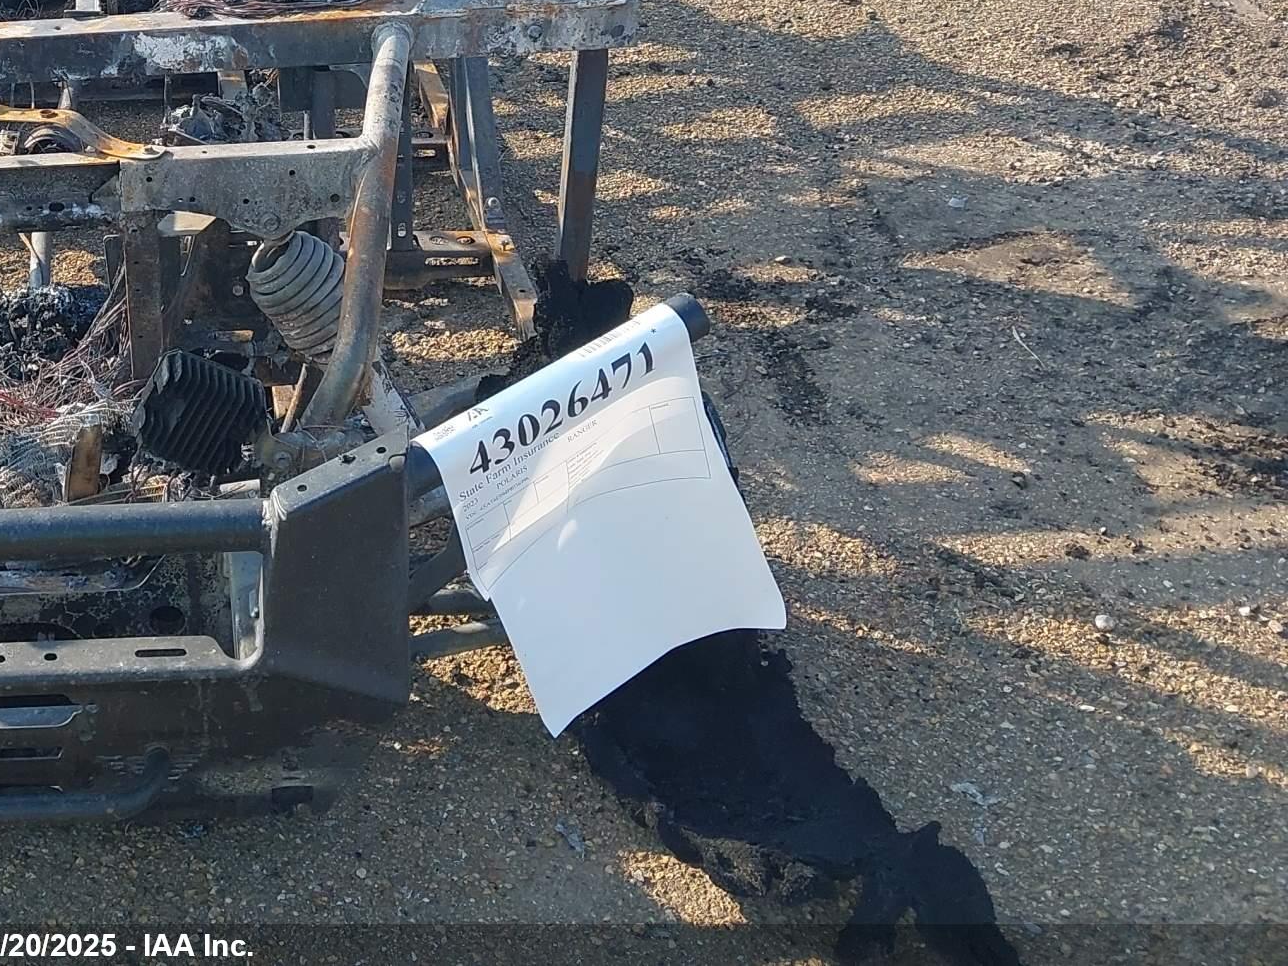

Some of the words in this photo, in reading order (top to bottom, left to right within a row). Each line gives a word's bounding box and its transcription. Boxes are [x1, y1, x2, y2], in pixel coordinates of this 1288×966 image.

[469, 341, 656, 475] 43026471
[459, 482, 484, 502] State
[485, 464, 511, 485] Farm
[512, 431, 561, 466] Insurance
[496, 465, 528, 490] POLARIS
